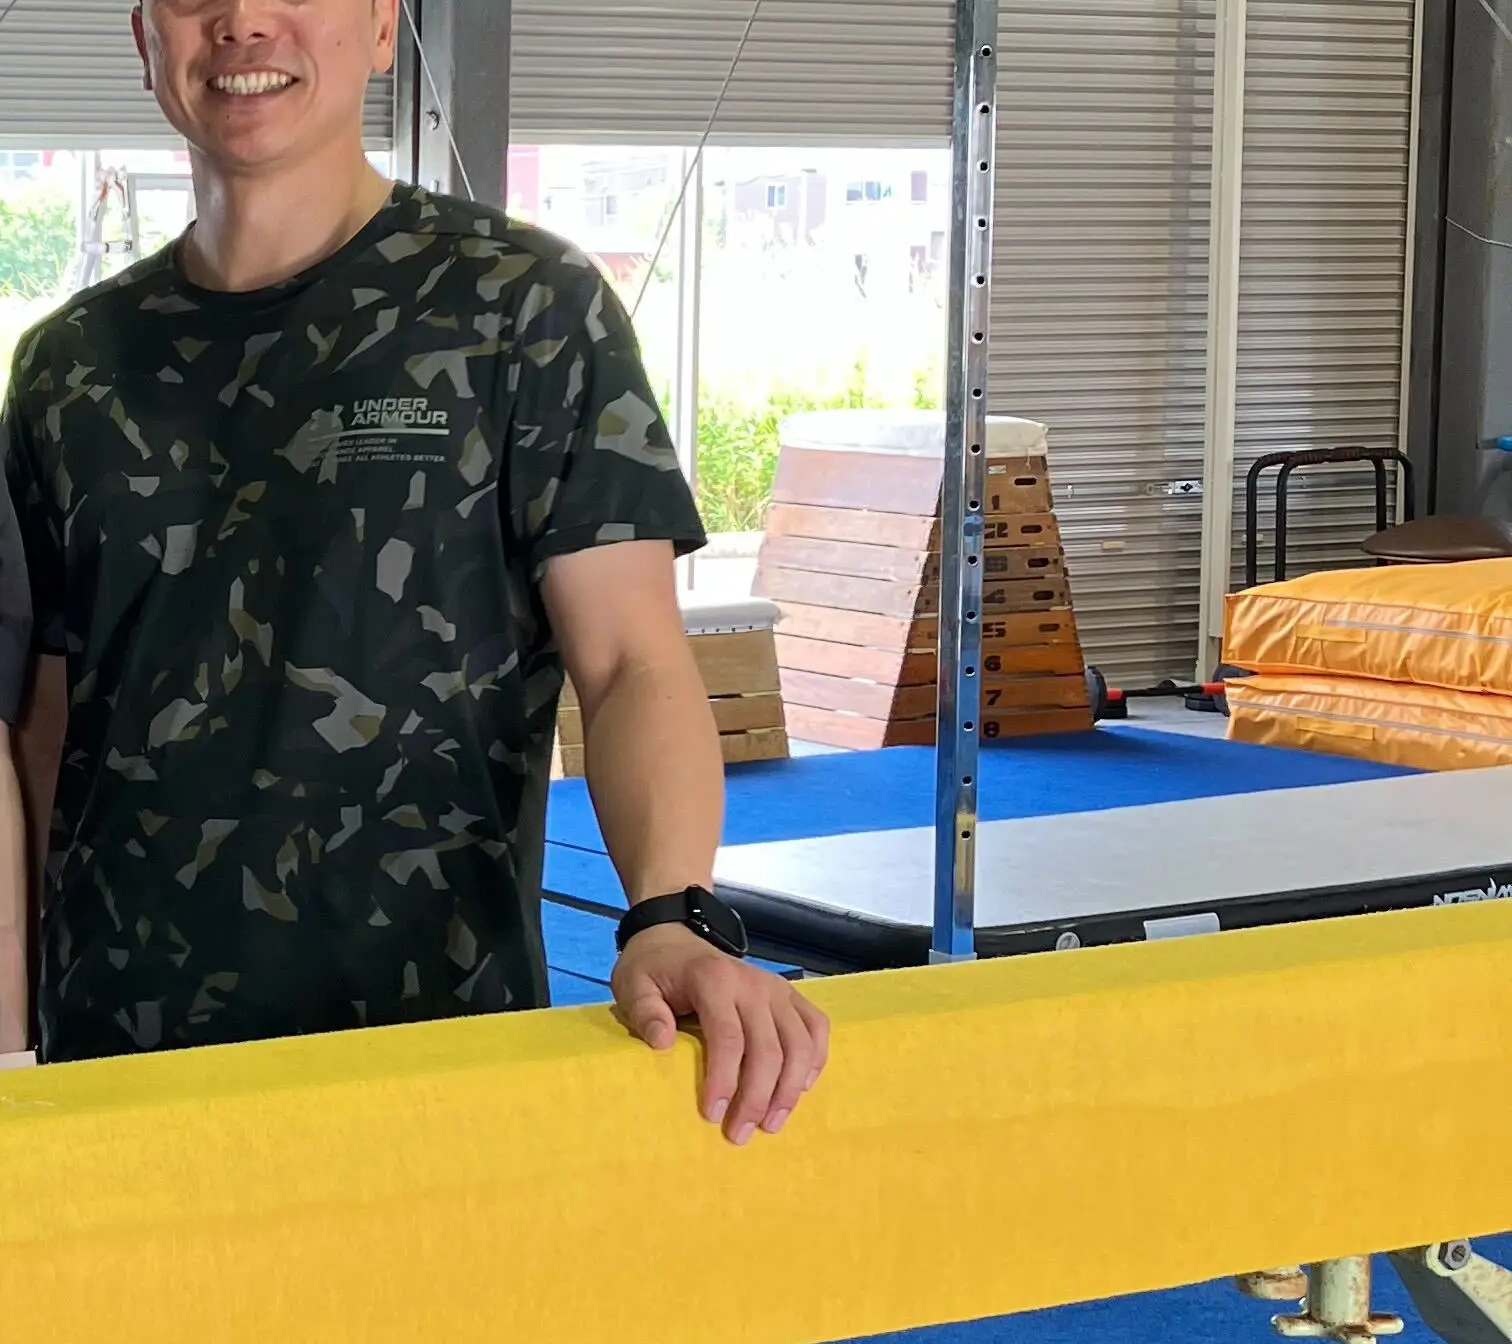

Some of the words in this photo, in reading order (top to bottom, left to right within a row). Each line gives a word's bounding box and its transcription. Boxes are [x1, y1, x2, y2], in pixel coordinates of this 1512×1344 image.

[354, 398, 428, 413] UNDER
[351, 411, 448, 426] ARMOUR
[982, 621, 1007, 638] 5
[983, 655, 1002, 672] 6
[985, 689, 1002, 706] 7
[983, 721, 1000, 738] 8
